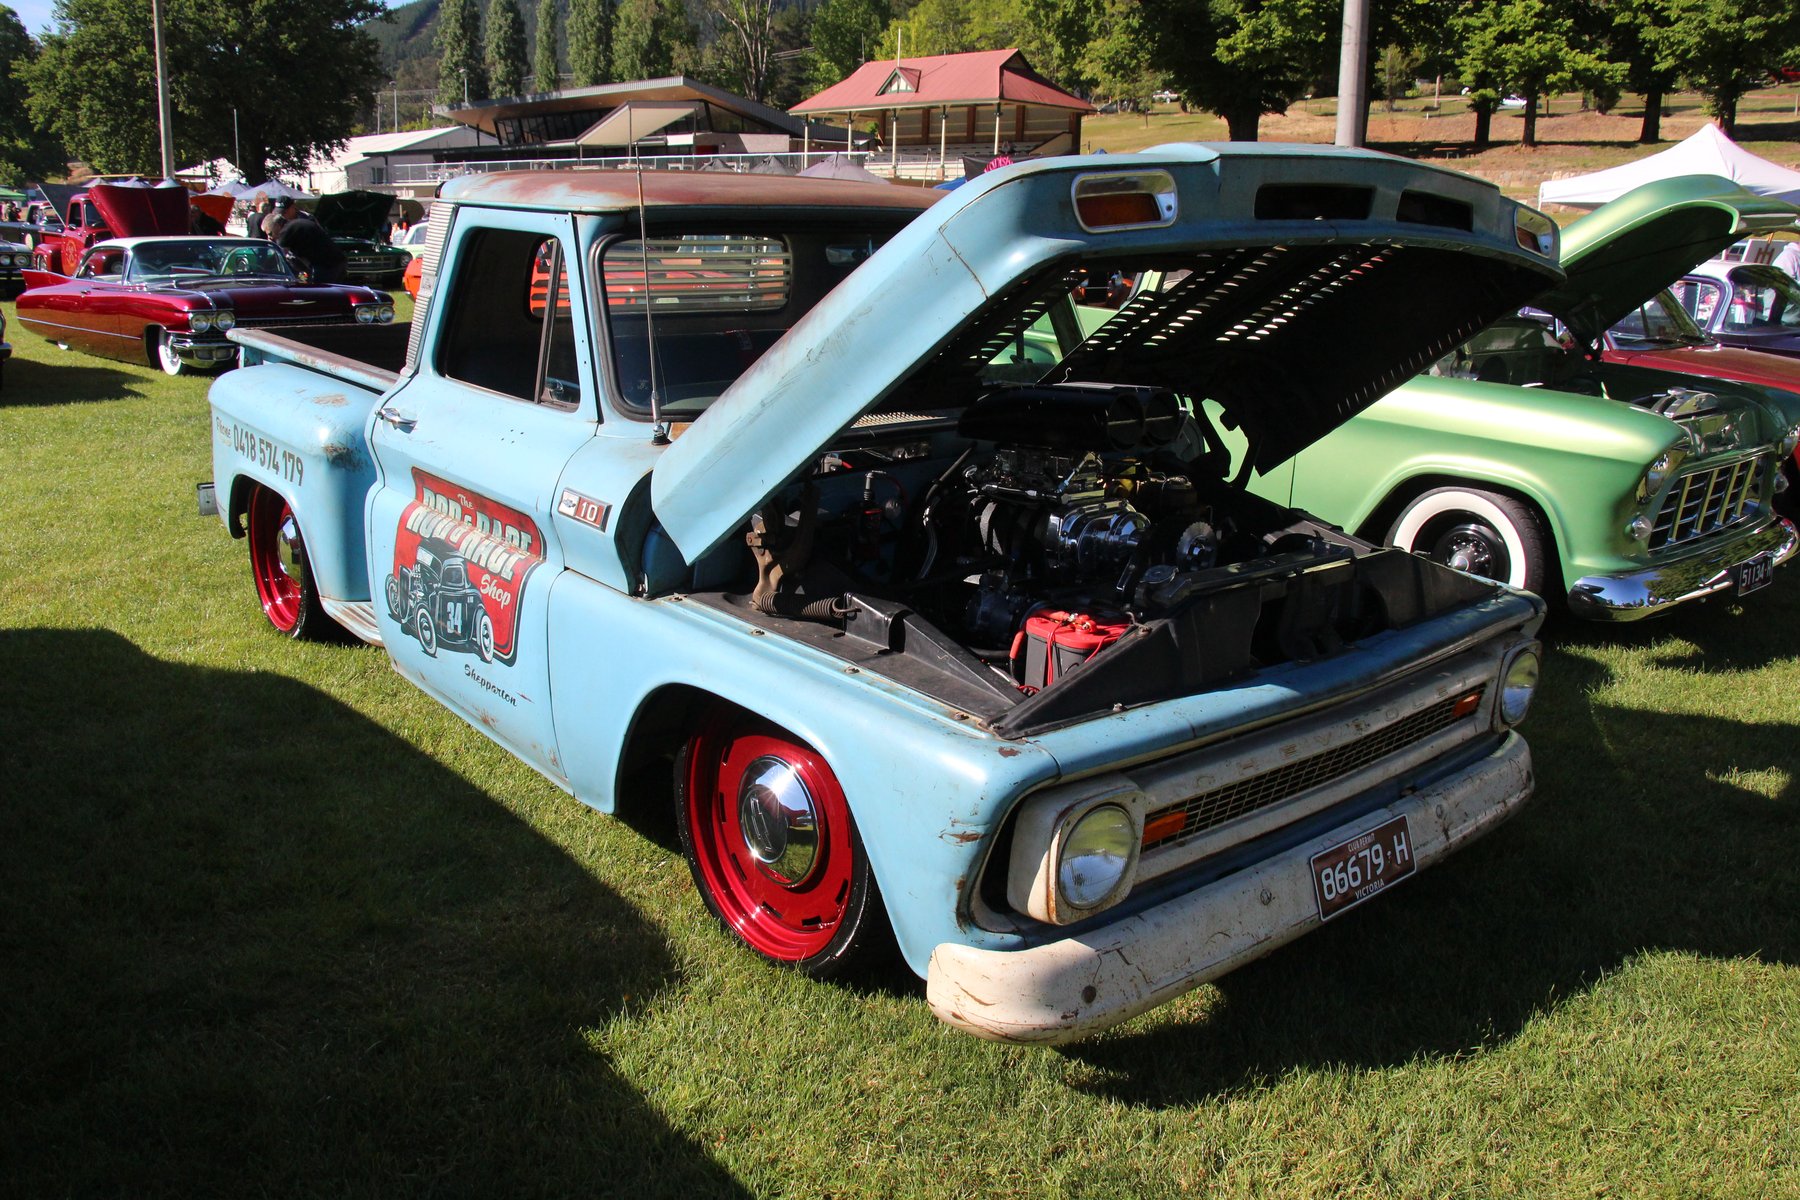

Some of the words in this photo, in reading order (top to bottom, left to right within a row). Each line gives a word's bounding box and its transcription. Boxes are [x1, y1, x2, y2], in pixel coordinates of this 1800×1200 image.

[233, 424, 257, 462] 0418
[258, 437, 280, 475] 574
[282, 450, 304, 487] 179
[456, 493, 475, 510] The
[580, 501, 599, 522] 10
[480, 573, 511, 609] Shop
[446, 601, 463, 634] 34
[464, 663, 518, 707] Shepparton
[1354, 878, 1385, 900] VICTORIA
